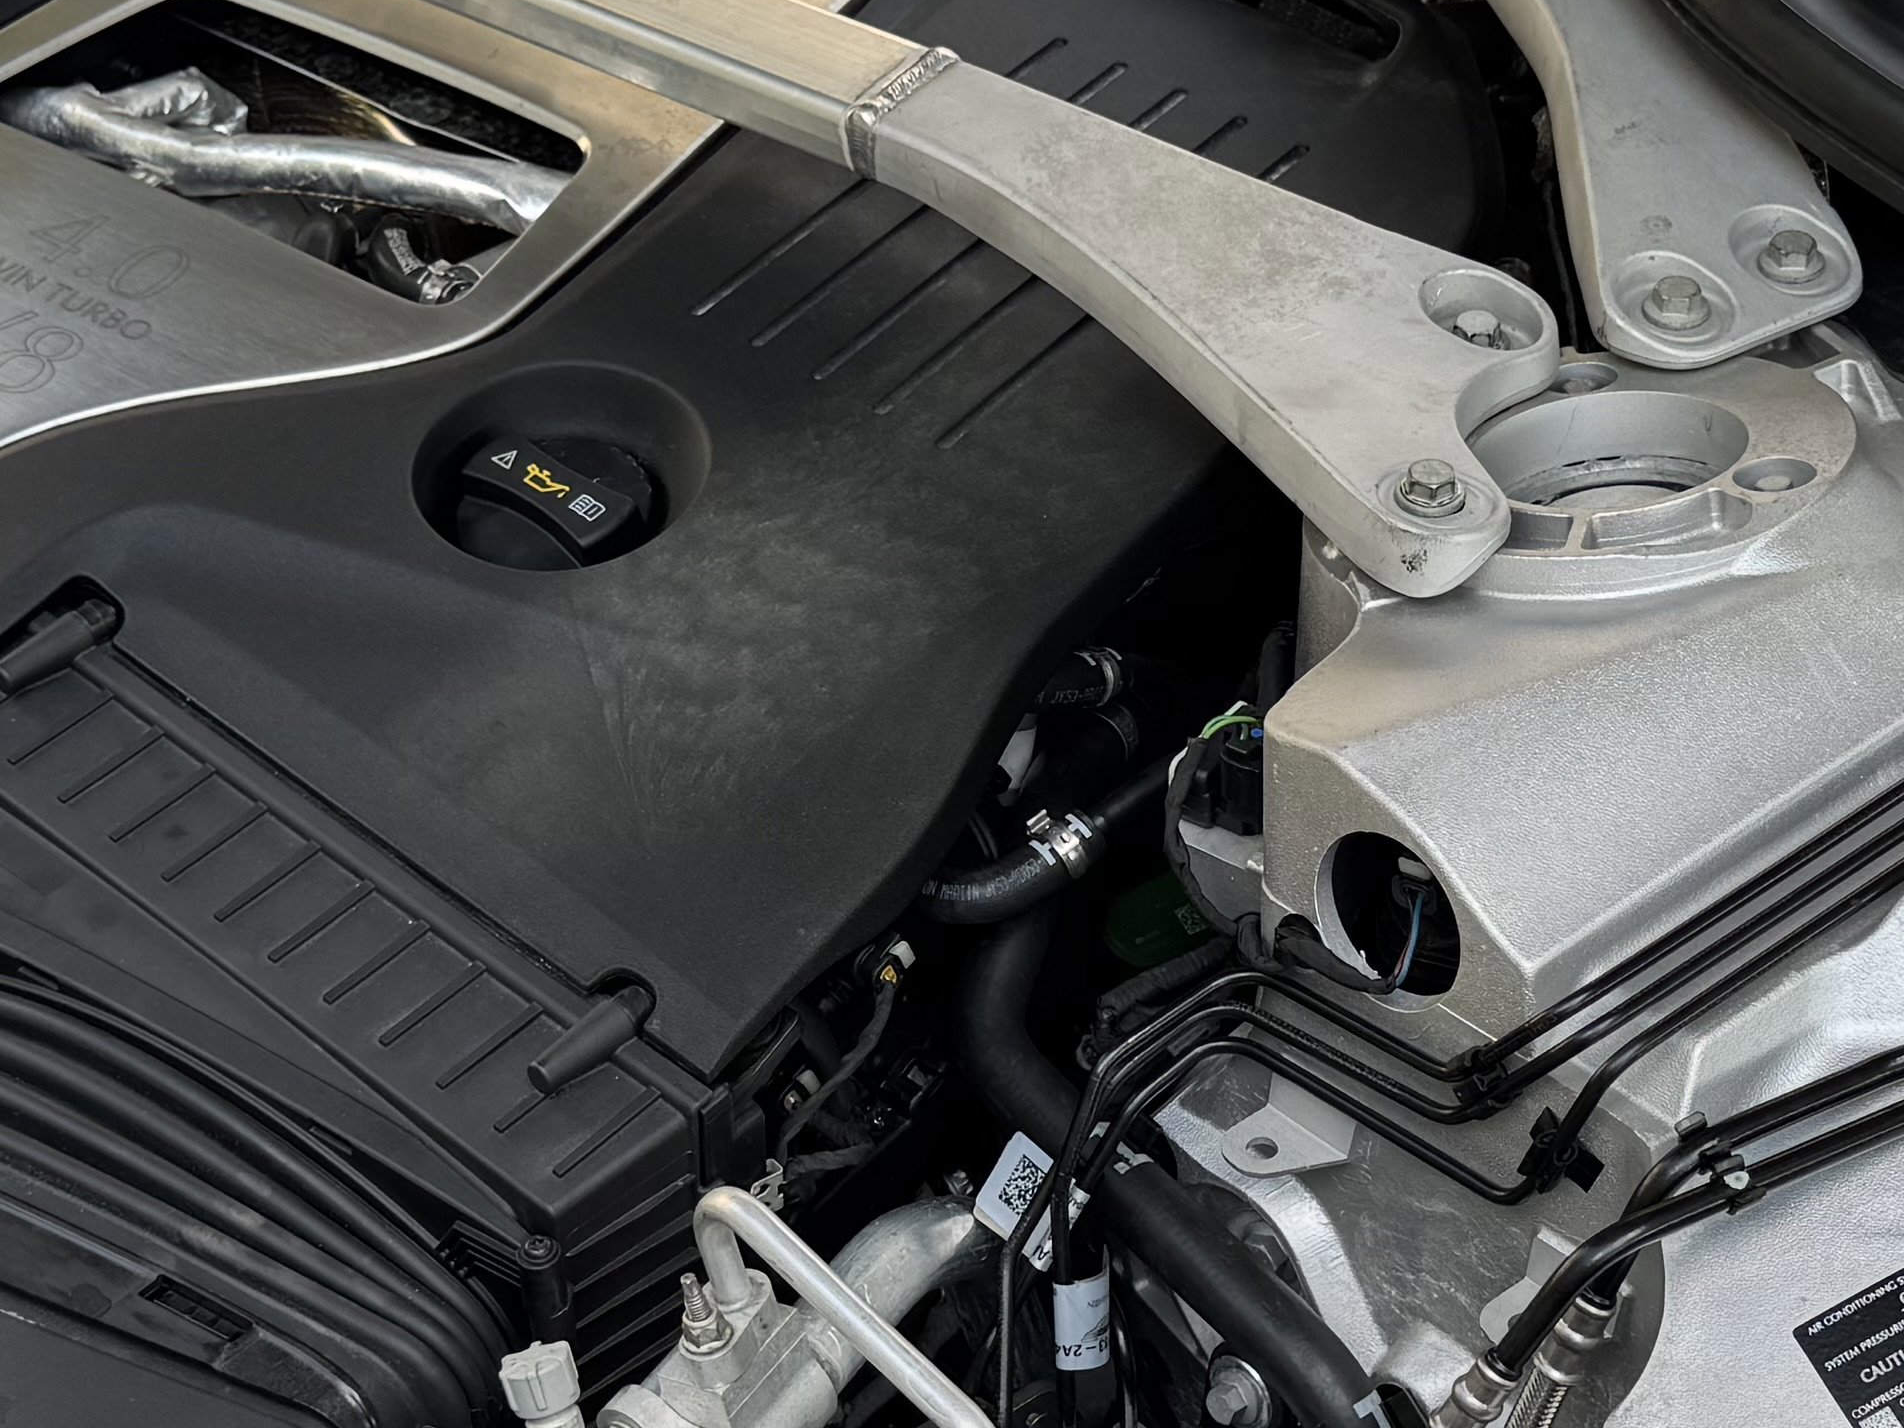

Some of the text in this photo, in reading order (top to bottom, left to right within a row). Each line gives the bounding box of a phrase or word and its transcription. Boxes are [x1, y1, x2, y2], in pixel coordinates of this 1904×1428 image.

[30, 213, 191, 301] 4.0
[44, 283, 151, 341] TURBO
[1807, 1321, 1825, 1336] AIR
[1823, 1280, 1898, 1326] CONDITIONING
[1824, 1345, 1861, 1372] SYSTEM
